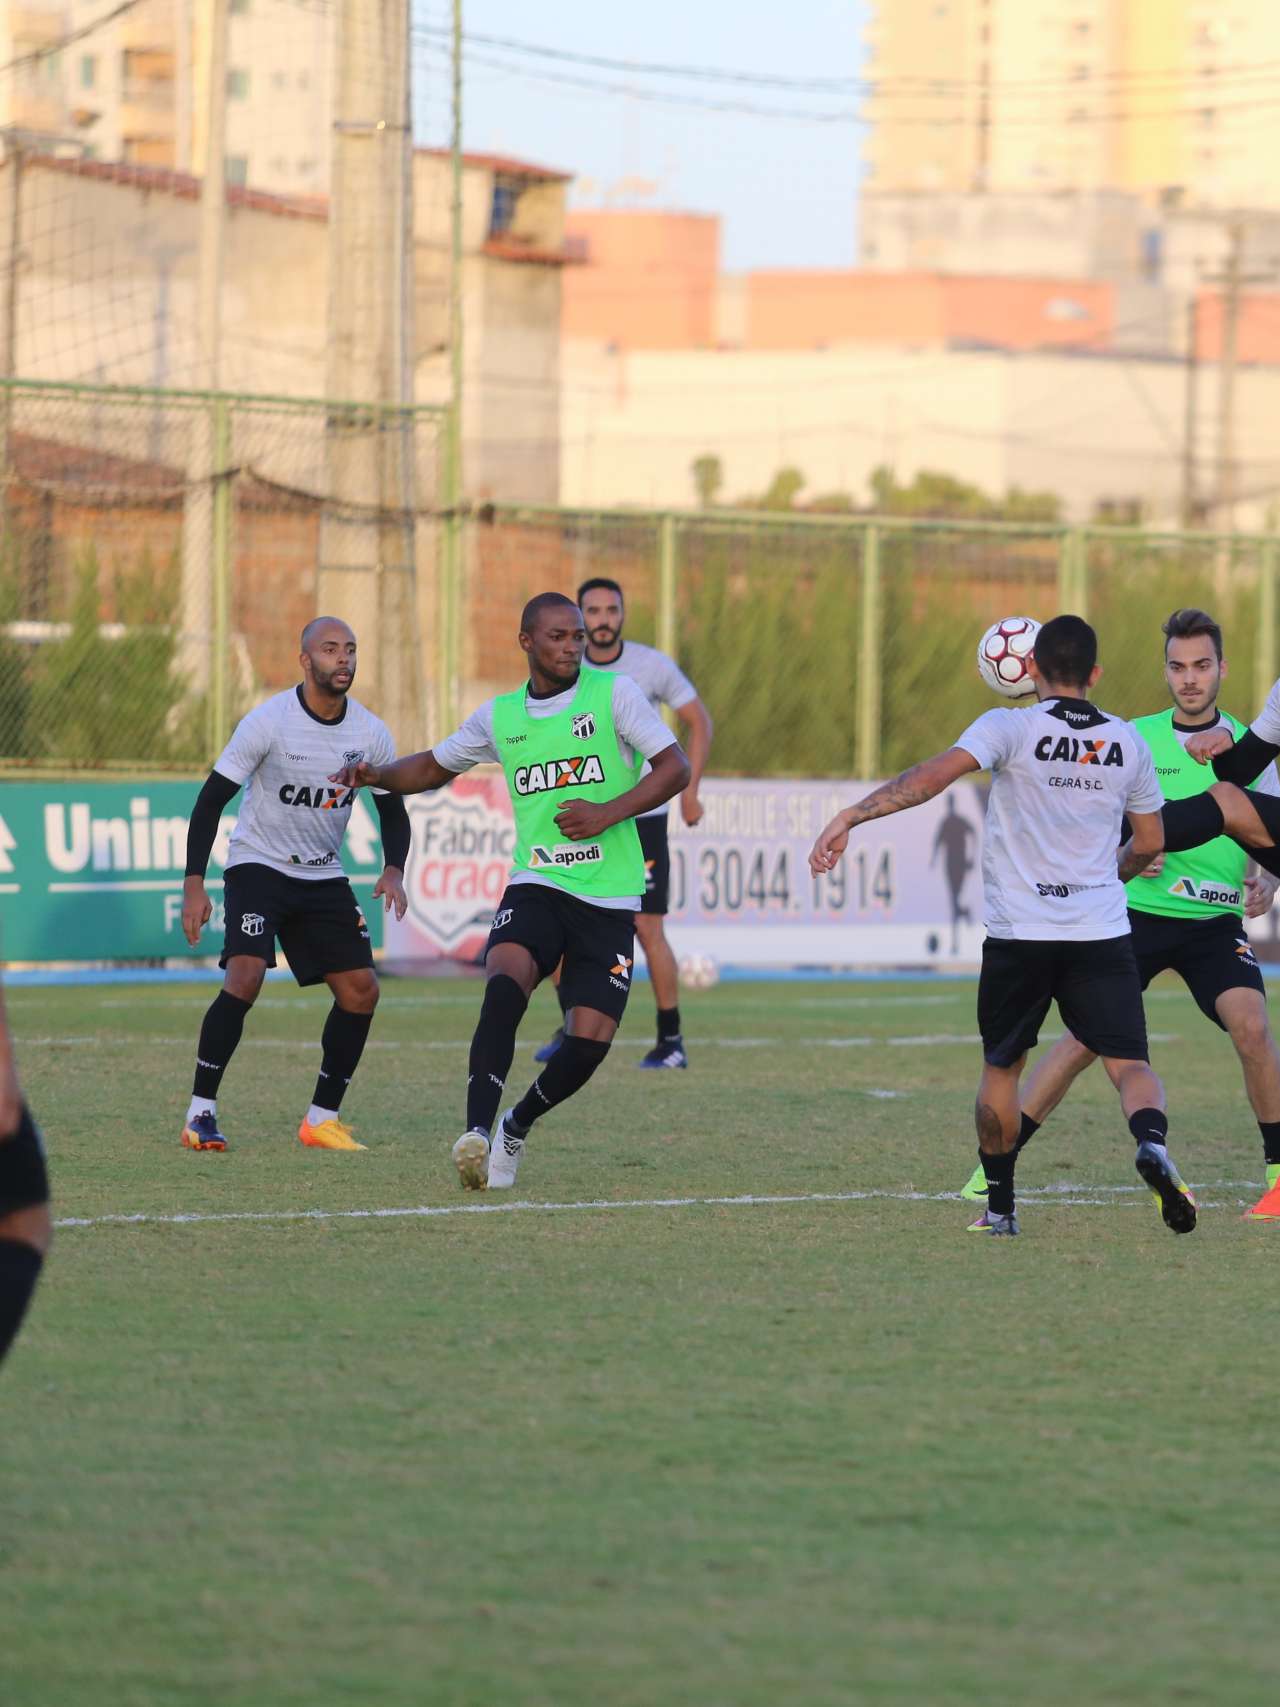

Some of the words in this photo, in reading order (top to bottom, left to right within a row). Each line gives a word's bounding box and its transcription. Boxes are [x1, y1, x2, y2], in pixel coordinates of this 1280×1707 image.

[1063, 710, 1091, 722] Topper
[505, 734, 528, 745] Topper
[284, 751, 309, 762] Topper
[1034, 735, 1124, 768] CAIXA
[514, 754, 606, 797] CAIXA
[422, 813, 514, 857] Fábric
[555, 845, 600, 866] apodi
[1200, 887, 1240, 905] apodi
